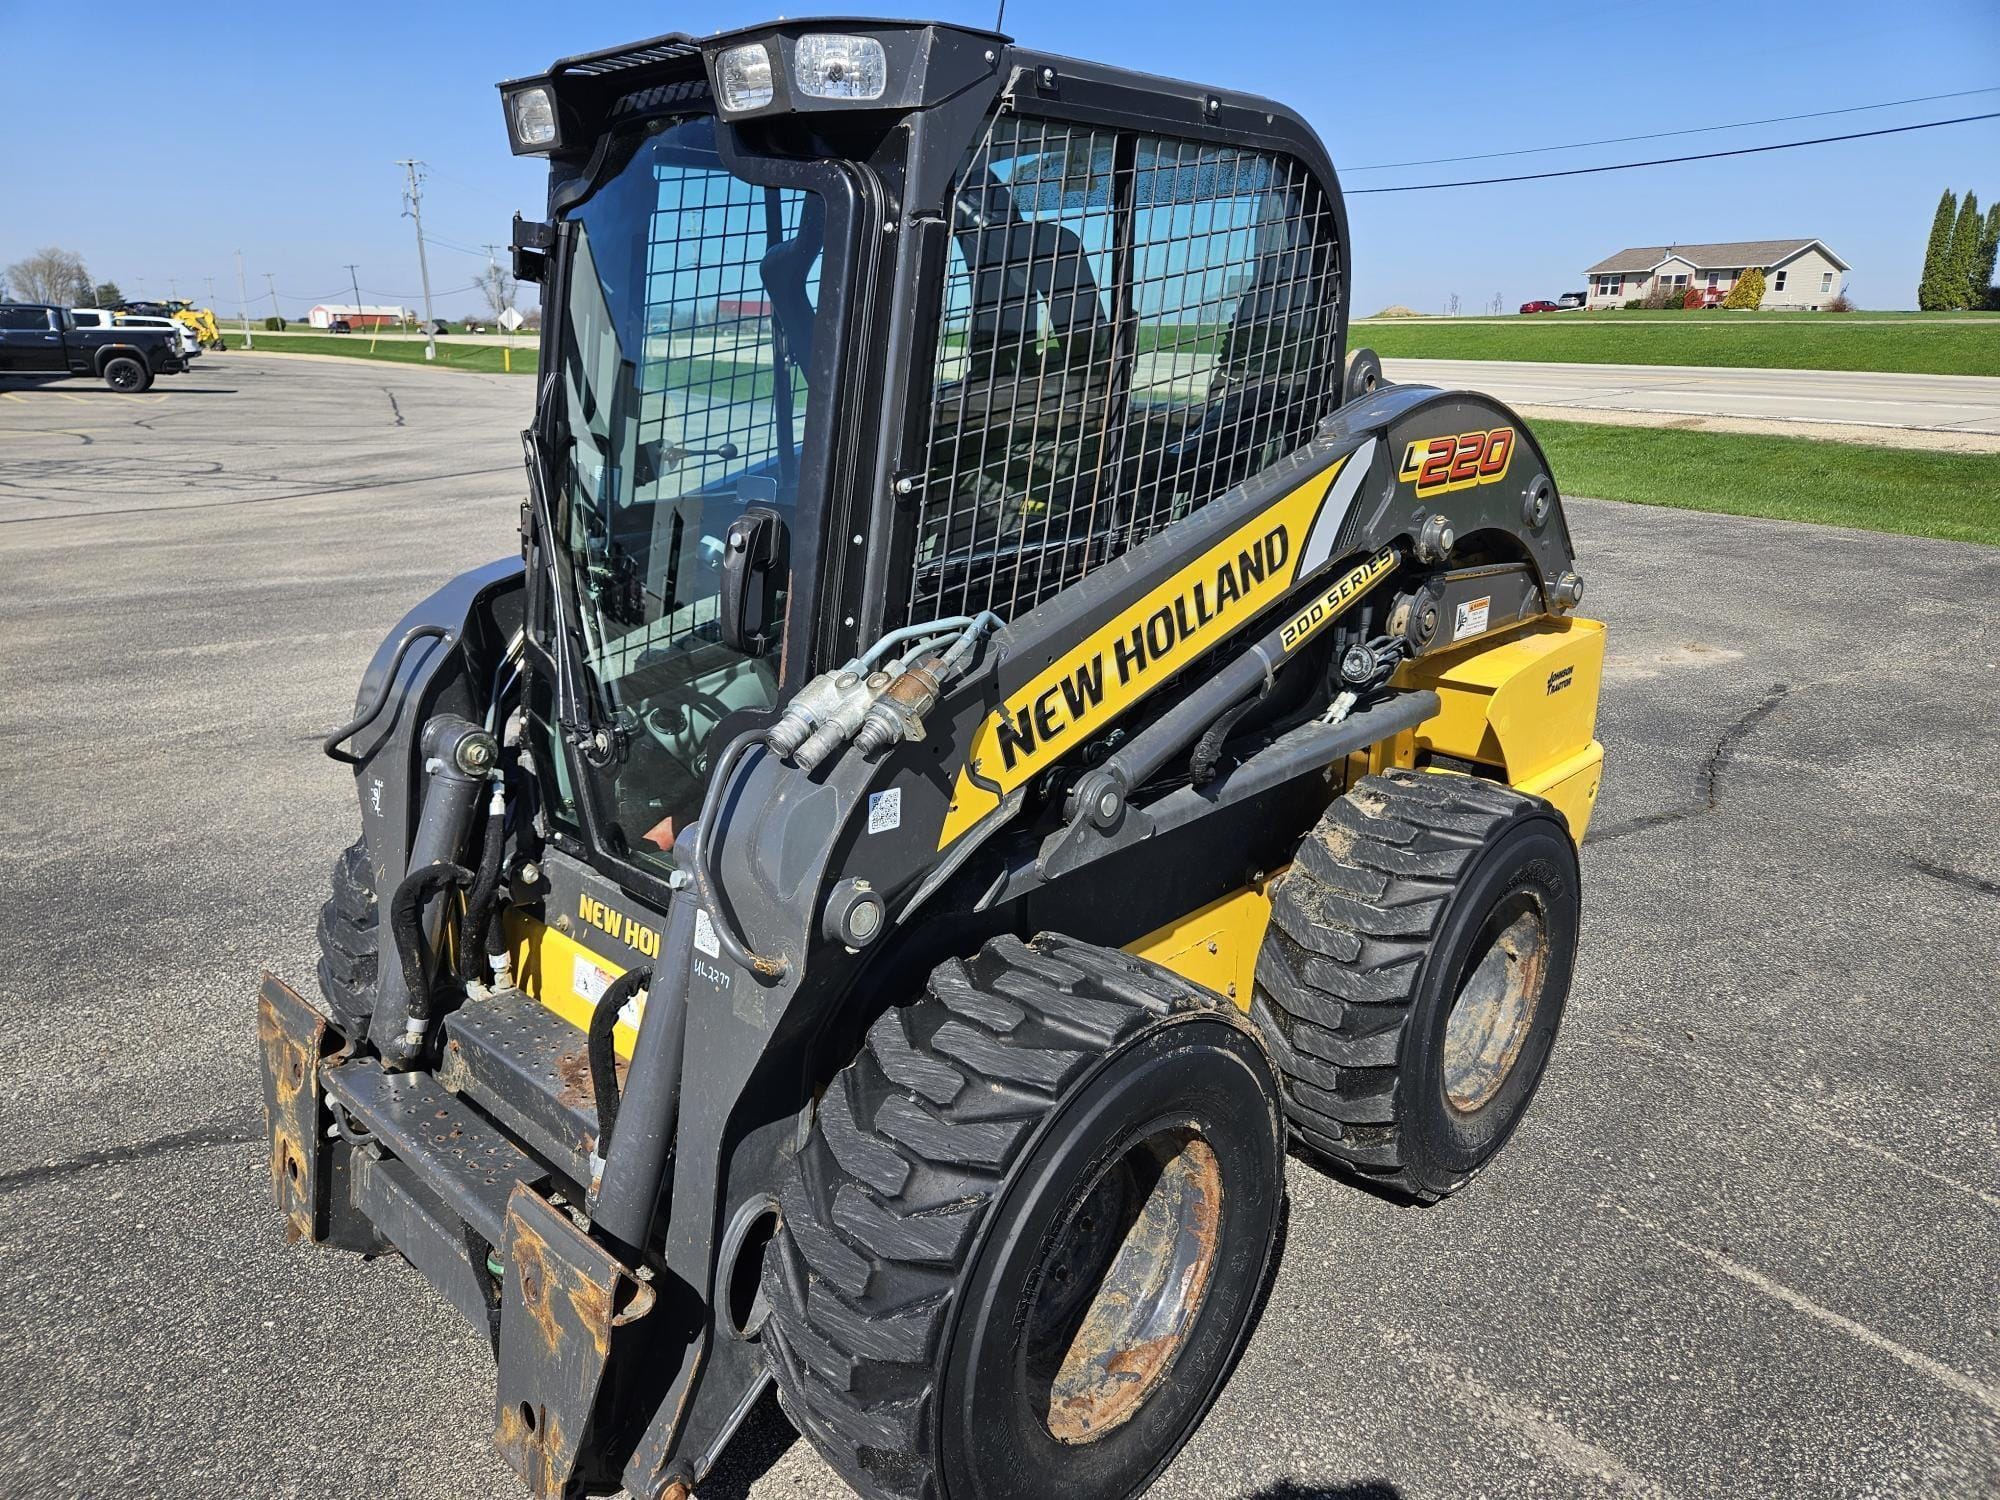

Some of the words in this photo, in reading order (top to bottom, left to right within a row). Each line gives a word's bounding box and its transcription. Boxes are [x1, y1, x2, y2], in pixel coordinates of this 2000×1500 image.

[1400, 428, 1514, 492] L220
[1283, 603, 1323, 647] 200
[1327, 547, 1392, 610] SERIES
[995, 650, 1104, 773] NEW
[1112, 523, 1290, 688] HOLLAND
[579, 893, 623, 938] NEW
